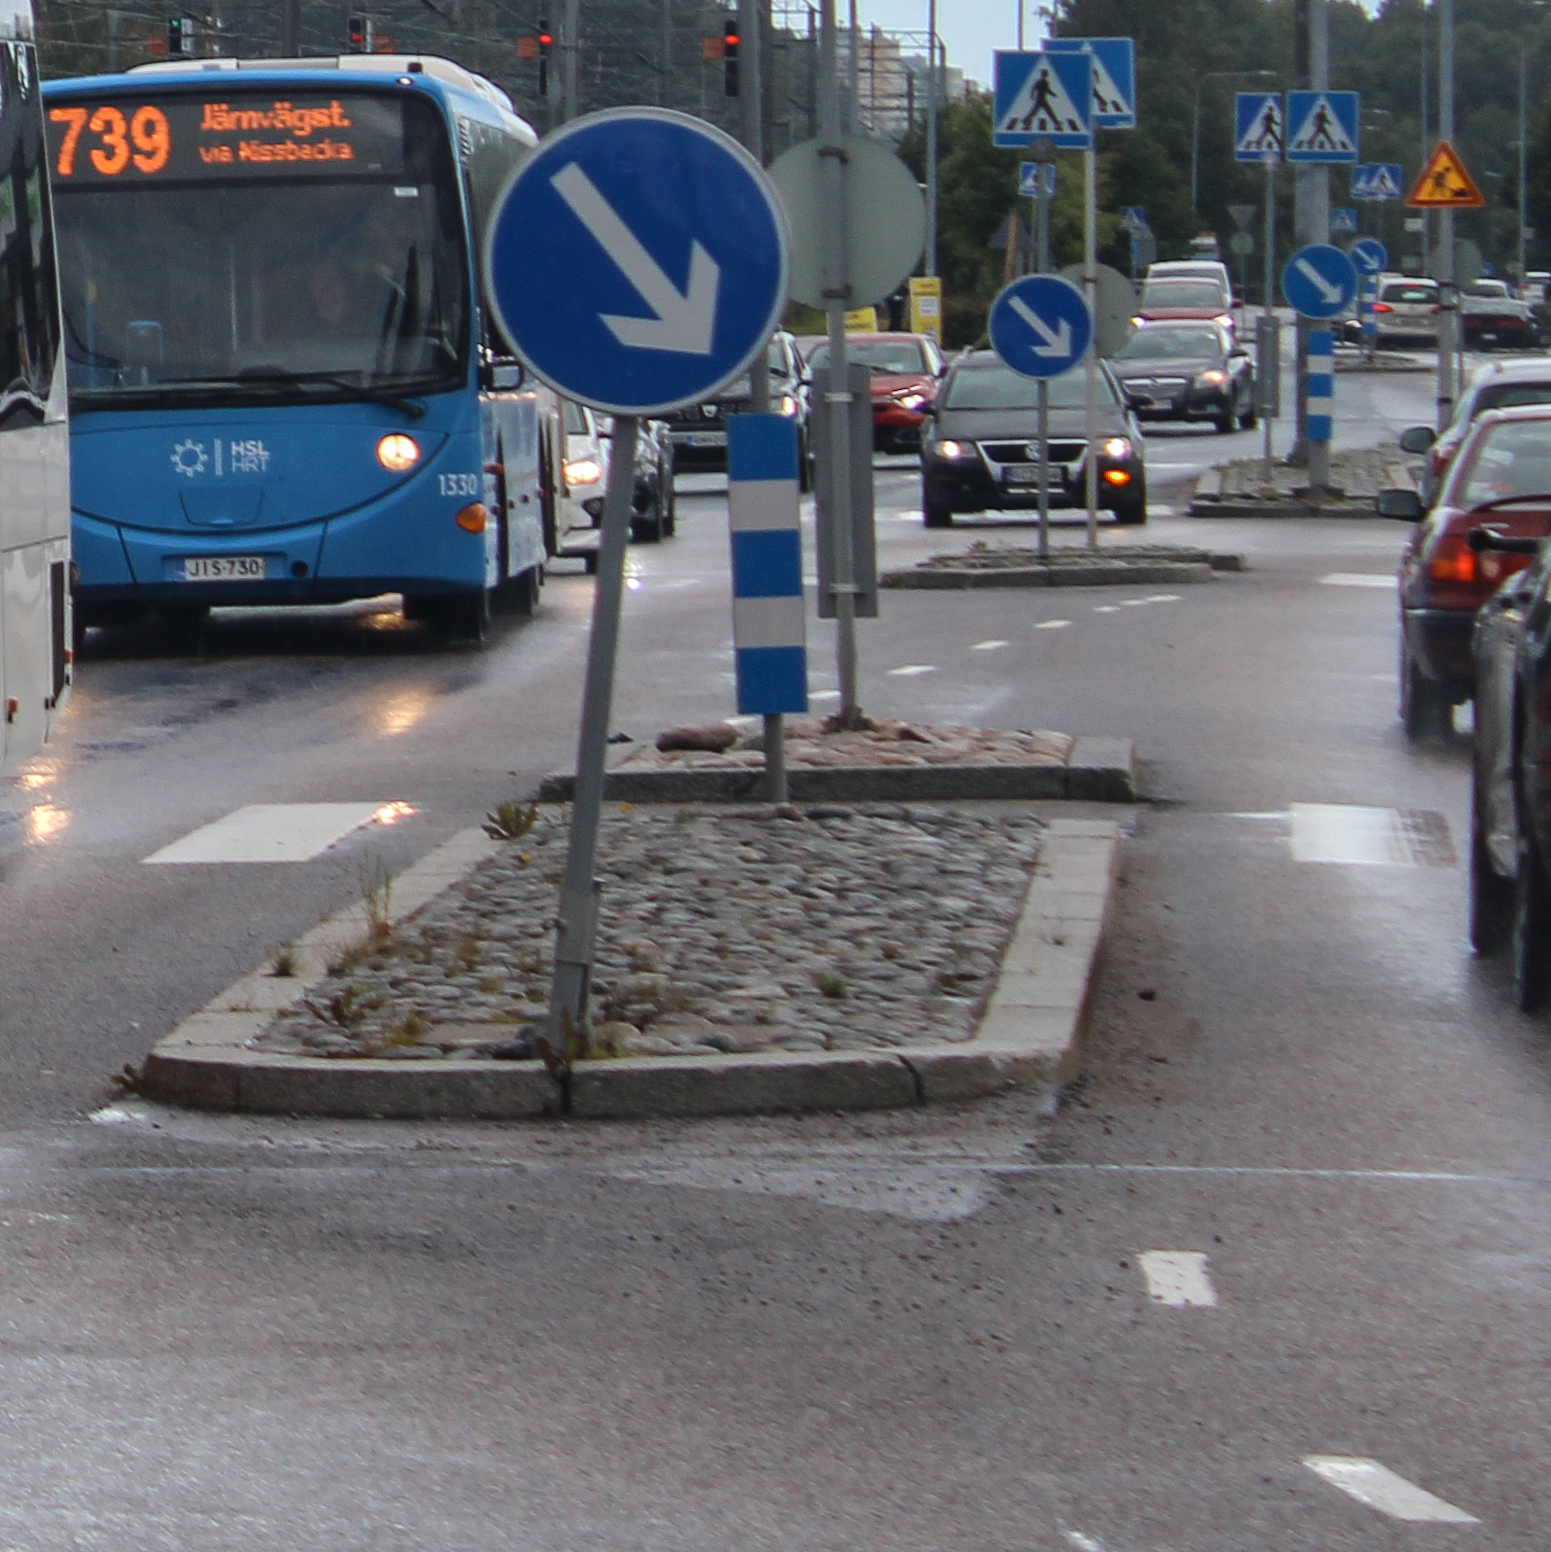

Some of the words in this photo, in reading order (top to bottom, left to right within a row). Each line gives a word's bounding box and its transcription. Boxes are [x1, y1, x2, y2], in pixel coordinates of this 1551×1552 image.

[49, 105, 171, 176] 739
[198, 143, 234, 163] via
[230, 439, 270, 456] HSL
[231, 455, 270, 473] HRT
[437, 473, 477, 496] 1330
[189, 559, 260, 577] JIS-730
